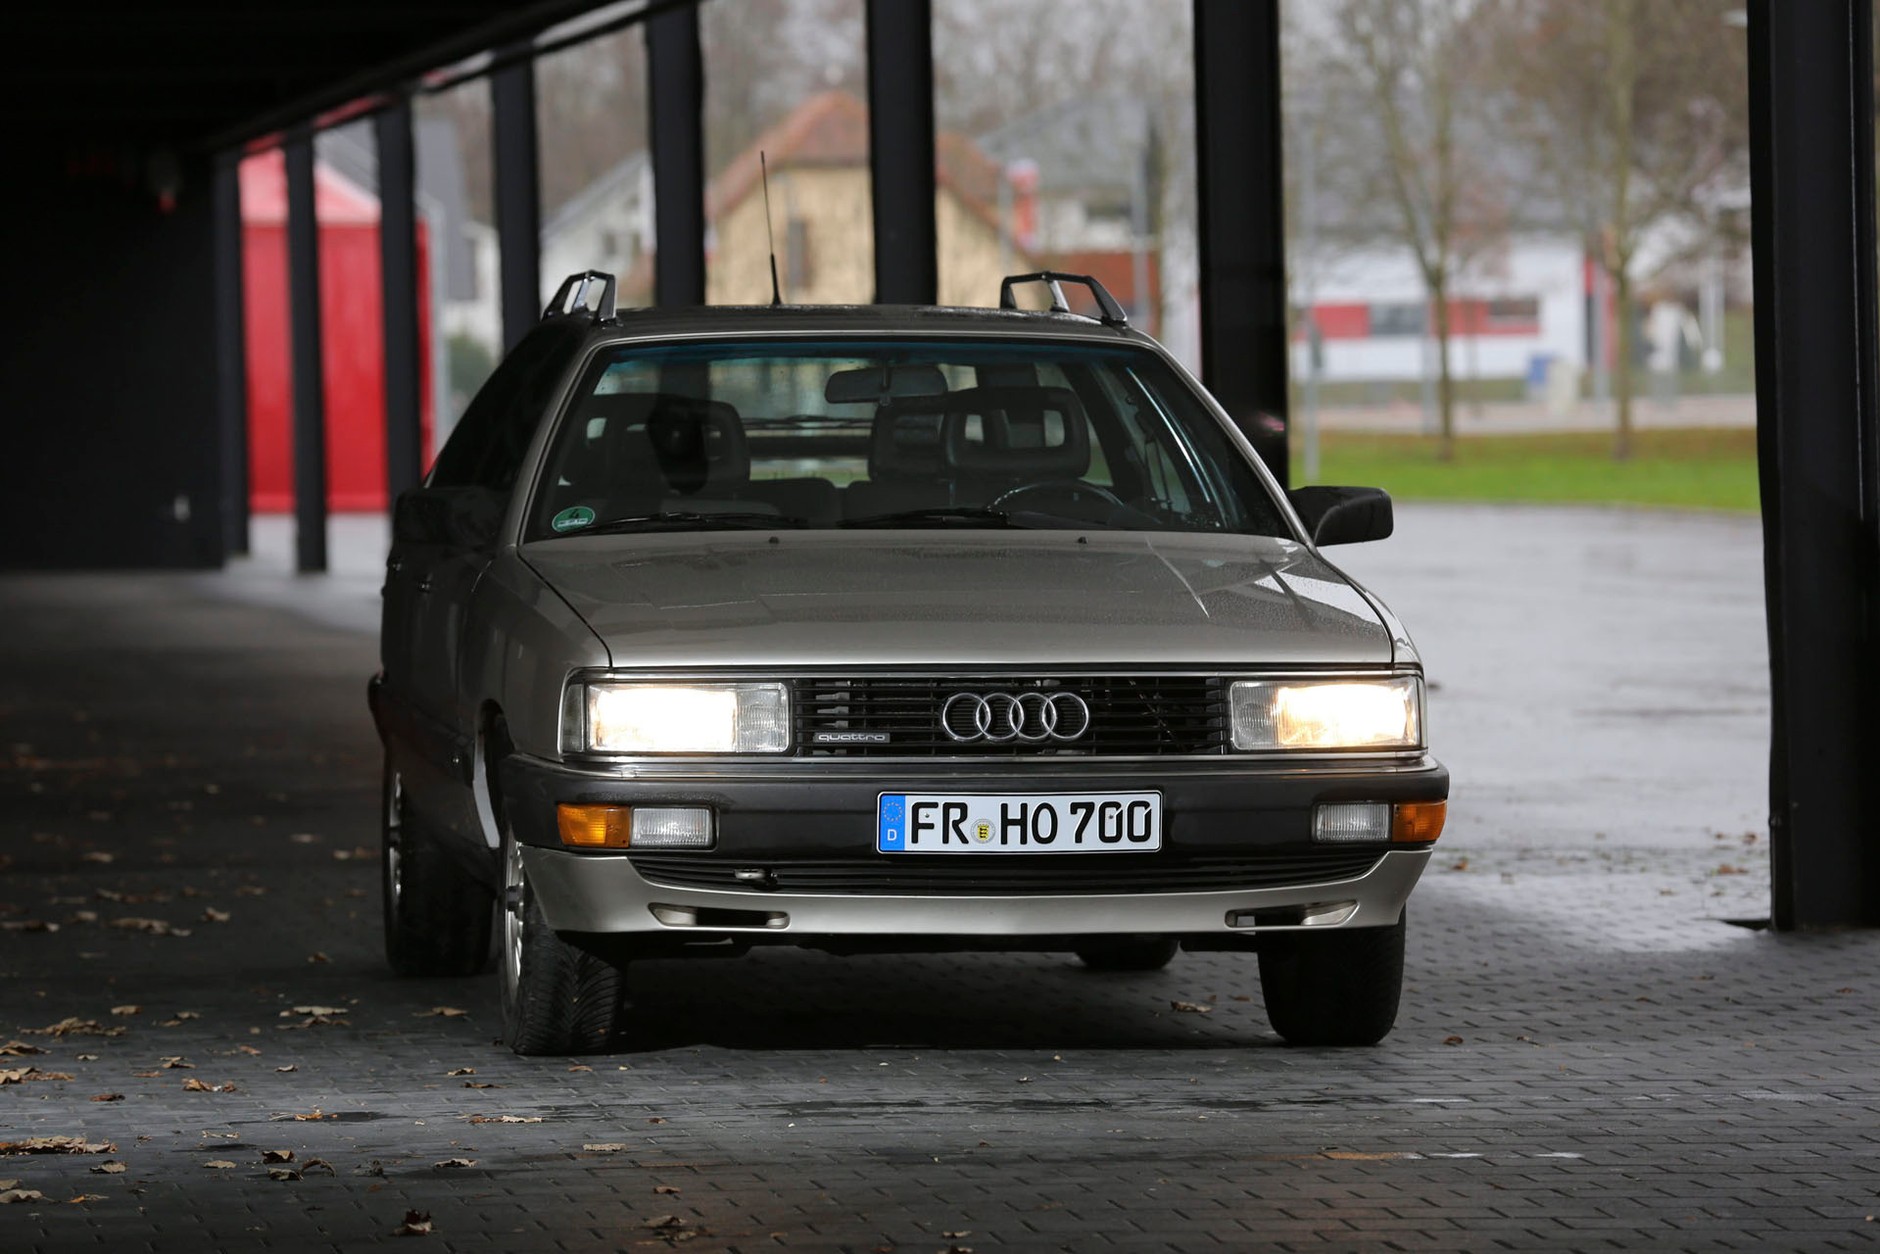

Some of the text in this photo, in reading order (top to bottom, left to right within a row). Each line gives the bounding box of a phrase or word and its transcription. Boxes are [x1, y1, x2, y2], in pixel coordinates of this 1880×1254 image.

[569, 508, 579, 518] 4
[818, 733, 885, 742] quattro
[911, 800, 1152, 845] FR HO 700
[887, 828, 897, 841] D
